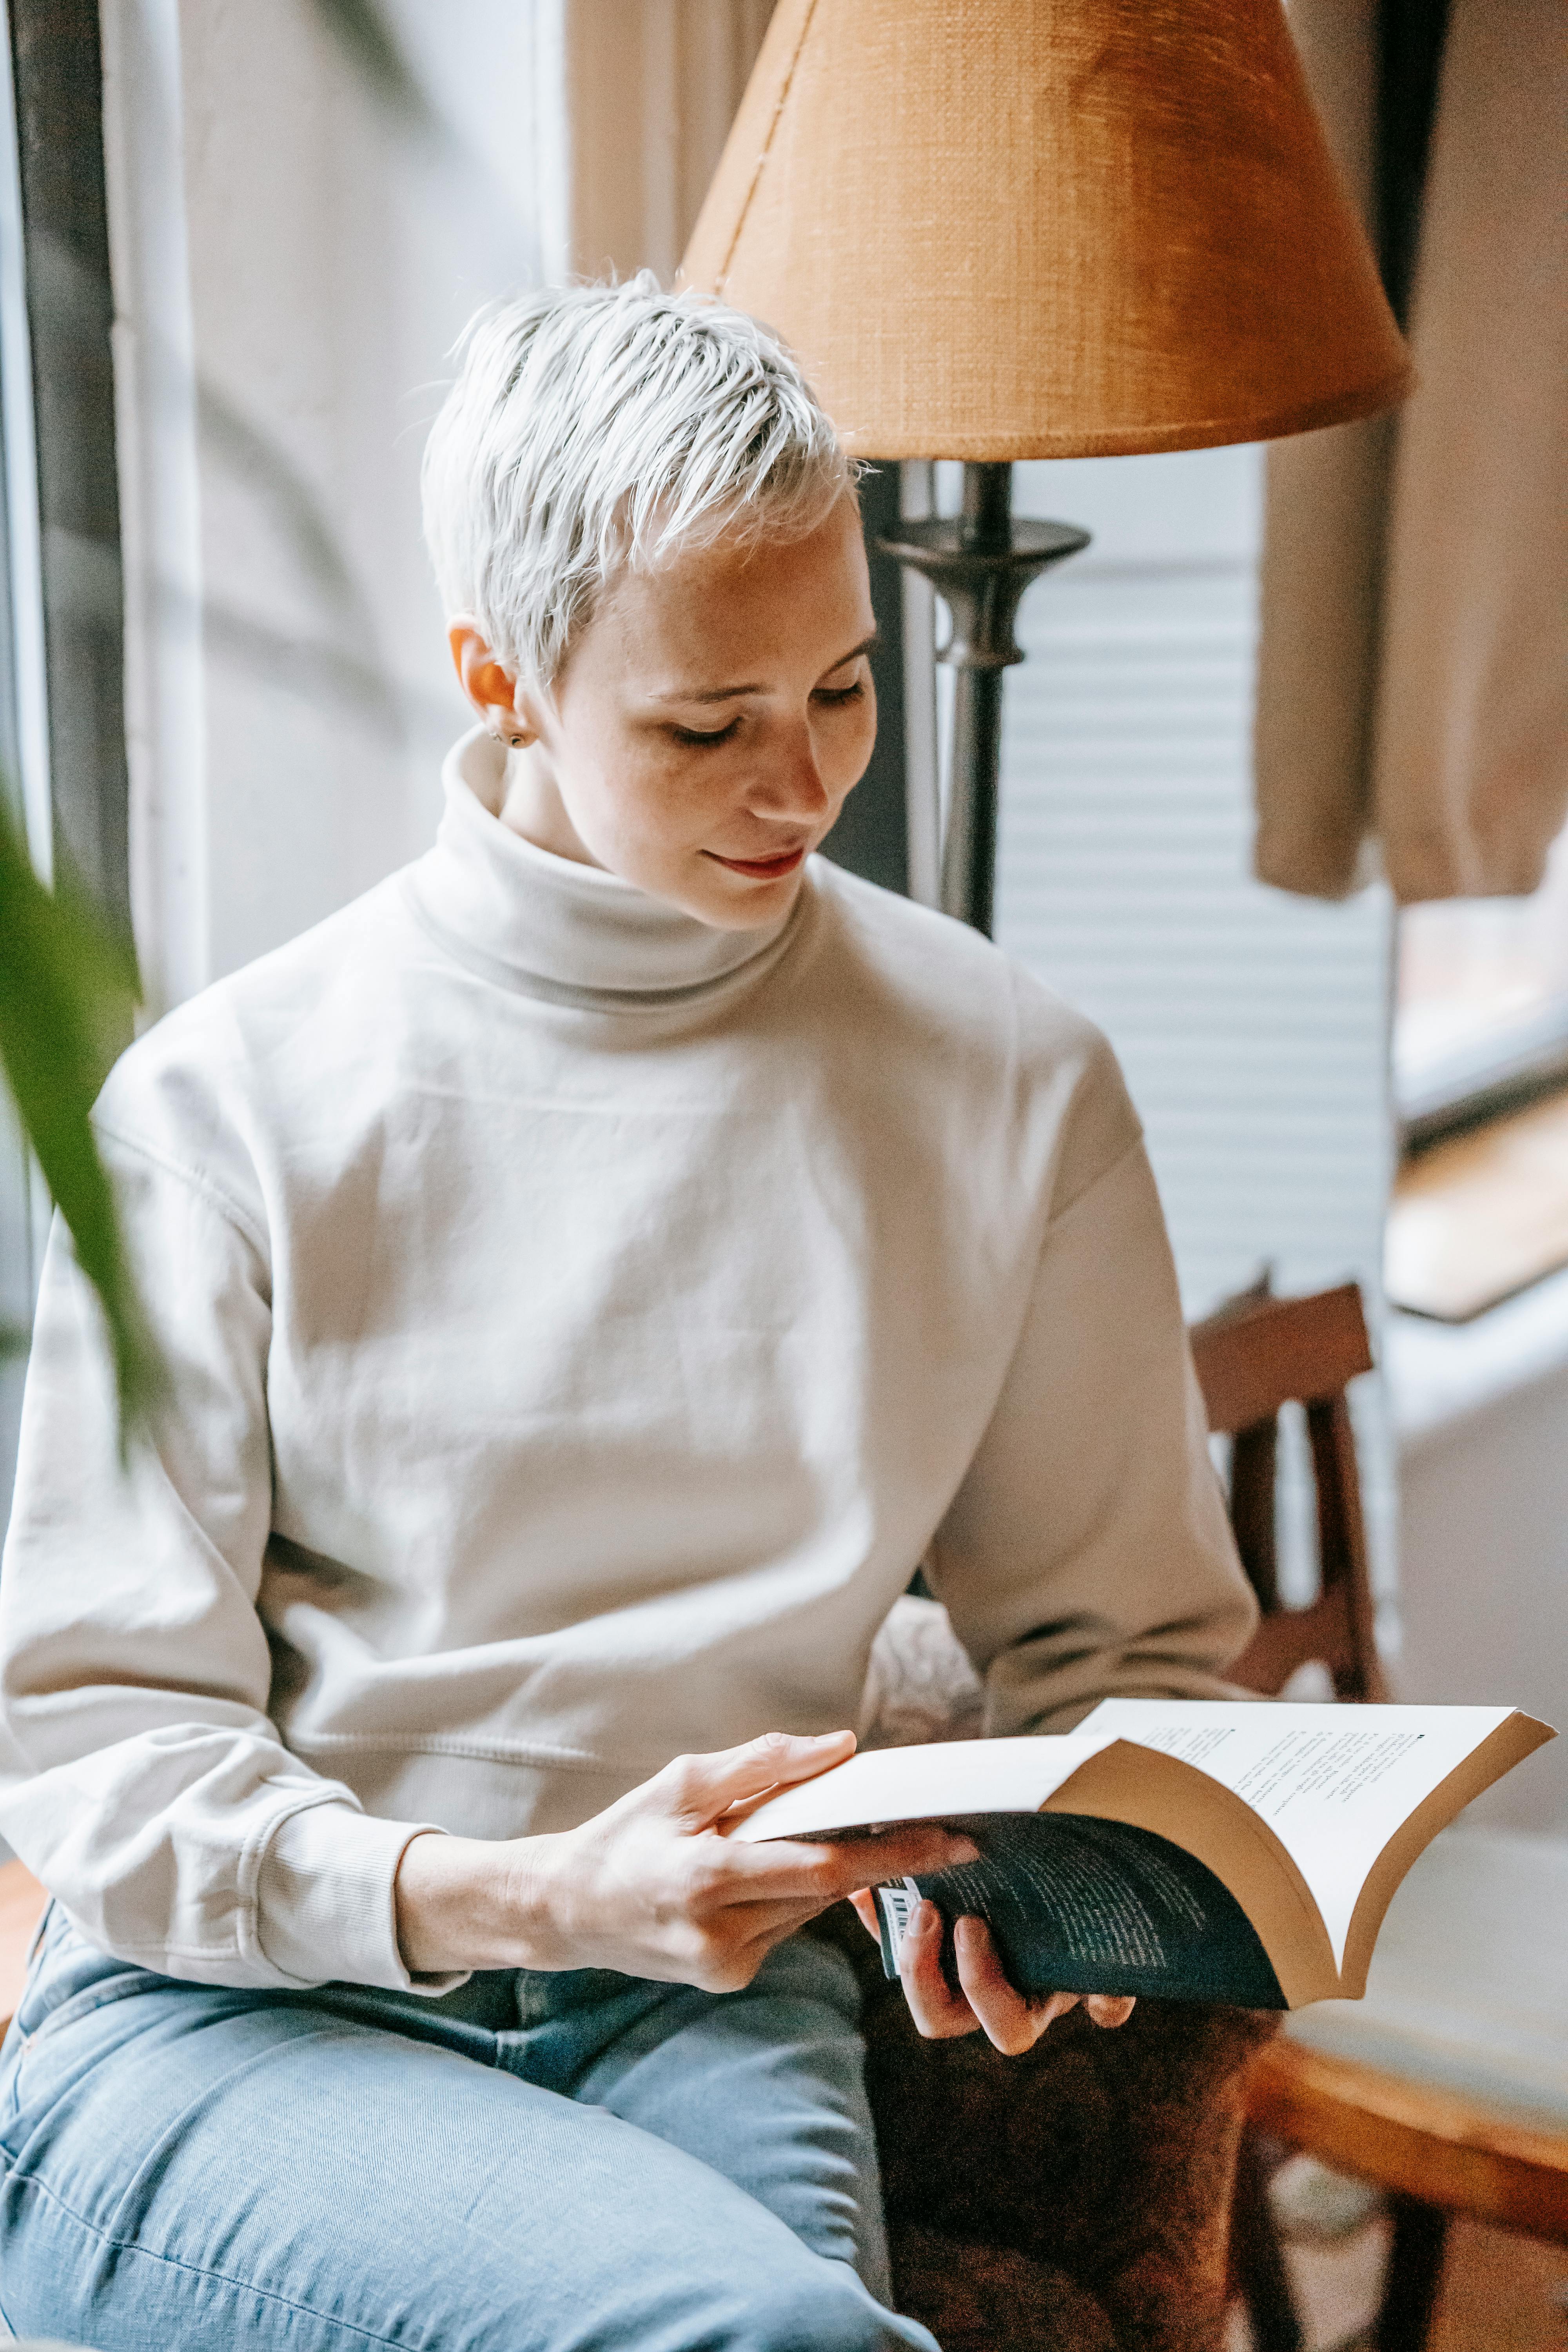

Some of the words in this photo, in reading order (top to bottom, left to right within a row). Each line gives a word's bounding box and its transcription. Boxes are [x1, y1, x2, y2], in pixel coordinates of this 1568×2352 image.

[1325, 1738, 1347, 1754] bomba
[1339, 1733, 1359, 1750] quando
[1352, 1733, 1368, 1747] anche
[1375, 1737, 1395, 1751] lunghi
[1394, 1734, 1414, 1751] sempre
[1408, 1735, 1425, 1747] Brina
[1327, 1752, 1339, 1760] udii
[1352, 1753, 1375, 1772] soliloqui
[1358, 1763, 1373, 1776] sopra
[1369, 1757, 1390, 1775] sempre
[1295, 1777, 1311, 1791] scogli
[1302, 1775, 1323, 1793] mattina
[1316, 1771, 1339, 1789] Ripenso
[1339, 1774, 1352, 1785] sulle
[1370, 1772, 1384, 1782] uniti
[1256, 1782, 1278, 1802] notturni
[1325, 1787, 1339, 1800] carte.
[1339, 1781, 1356, 1794] tavoli
[1342, 1783, 1364, 1802] disparte
[1273, 1792, 1296, 1816] crepitare
